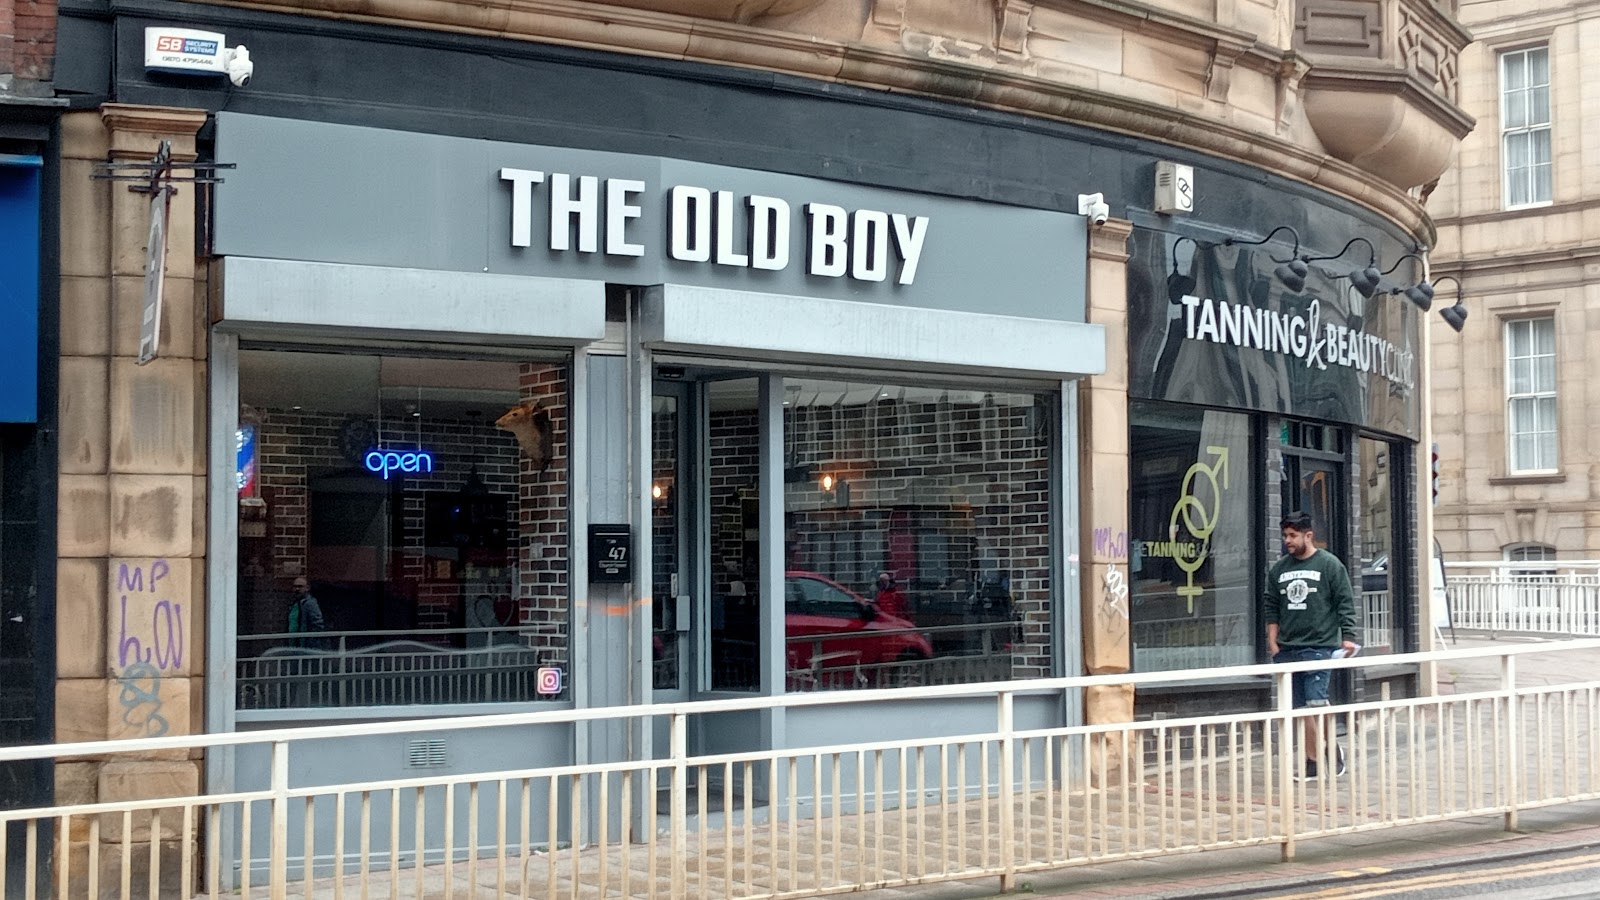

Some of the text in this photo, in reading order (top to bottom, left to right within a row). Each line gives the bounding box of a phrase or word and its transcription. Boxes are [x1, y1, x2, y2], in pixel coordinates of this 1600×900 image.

[158, 38, 183, 51] SB
[185, 40, 217, 49] SECURITY
[499, 167, 930, 285] THE OLD BOY
[1181, 294, 1307, 358] TANNING
[1326, 322, 1387, 377] BEAUTY
[365, 451, 432, 480] open
[608, 546, 627, 560] 47
[1146, 541, 1196, 558] TANNING
